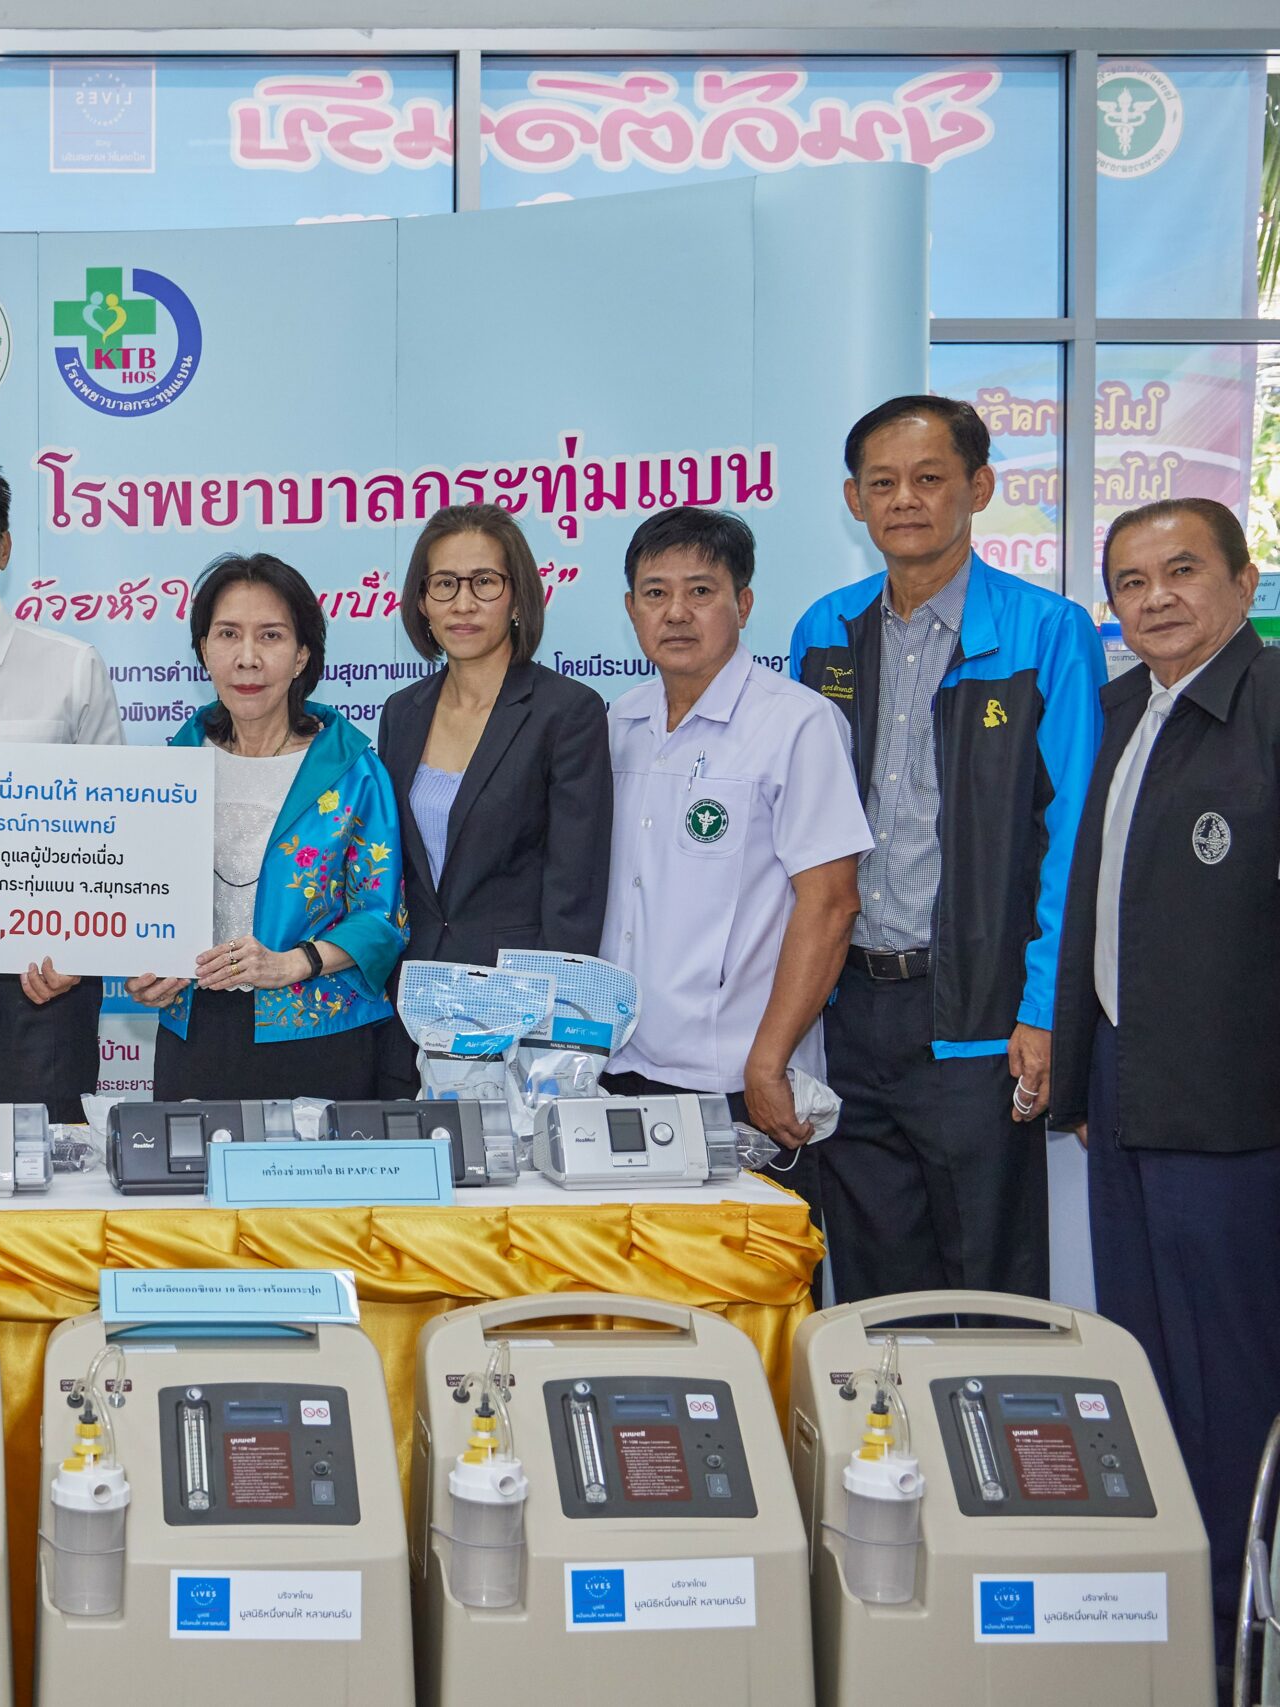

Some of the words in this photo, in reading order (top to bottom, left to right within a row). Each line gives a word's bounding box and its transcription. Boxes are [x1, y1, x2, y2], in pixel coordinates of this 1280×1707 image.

[94, 347, 157, 370] KTB
[63, 355, 194, 412] โรงพยาบาลกระทุ่มแบน
[122, 371, 157, 384] HOS
[37, 435, 775, 540] โรงพยาบาลกระทุ่มแบน
[14, 576, 190, 622] ด้วยหัวใ
[85, 782, 198, 804] หลายคนรับ
[79, 880, 170, 899] จ.สมุทรสาคร
[135, 920, 176, 939] บาท
[335, 1167, 345, 1175] Bi
[380, 1166, 400, 1175] PAP
[230, 1436, 256, 1445] yuwell
